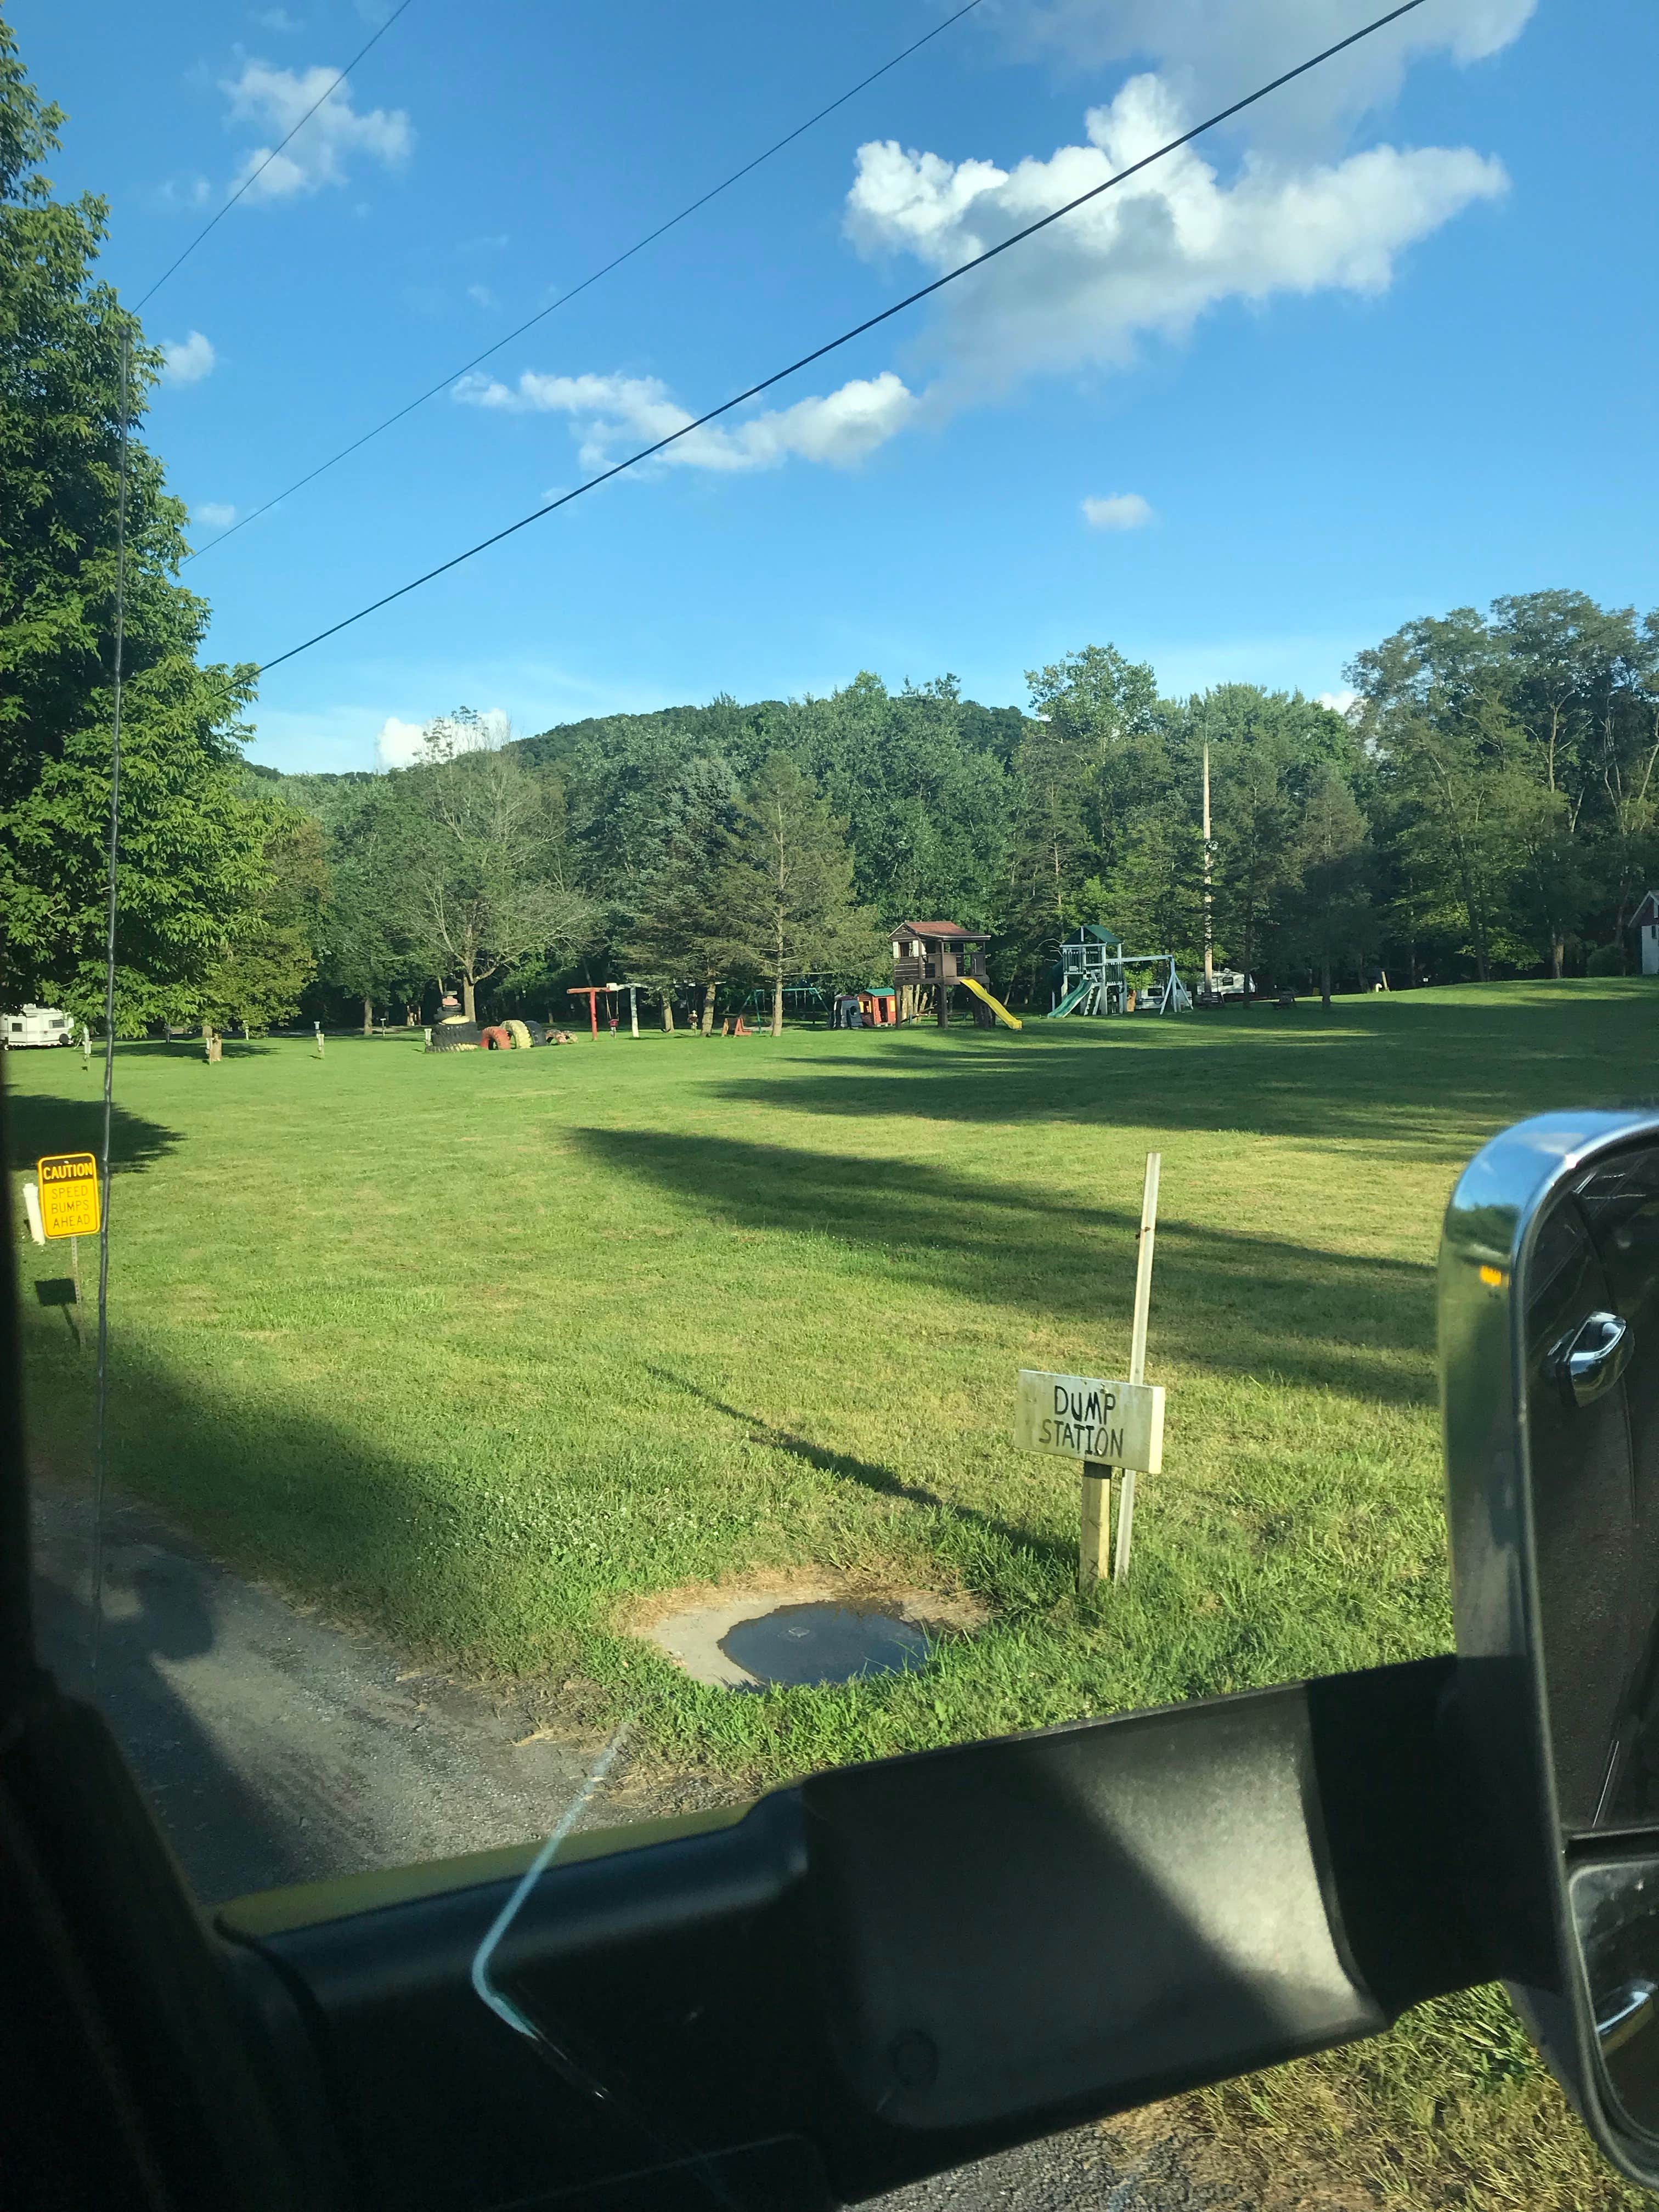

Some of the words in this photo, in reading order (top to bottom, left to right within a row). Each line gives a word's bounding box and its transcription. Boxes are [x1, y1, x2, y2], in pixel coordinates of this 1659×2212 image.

[43, 1162, 93, 1180] CAUTION
[52, 1185, 88, 1199] SPEED
[51, 1200, 89, 1214] BUMPS
[53, 1214, 90, 1229] AHEAD
[1054, 1385, 1116, 1425] DUMP
[1039, 1419, 1124, 1458] STATION
